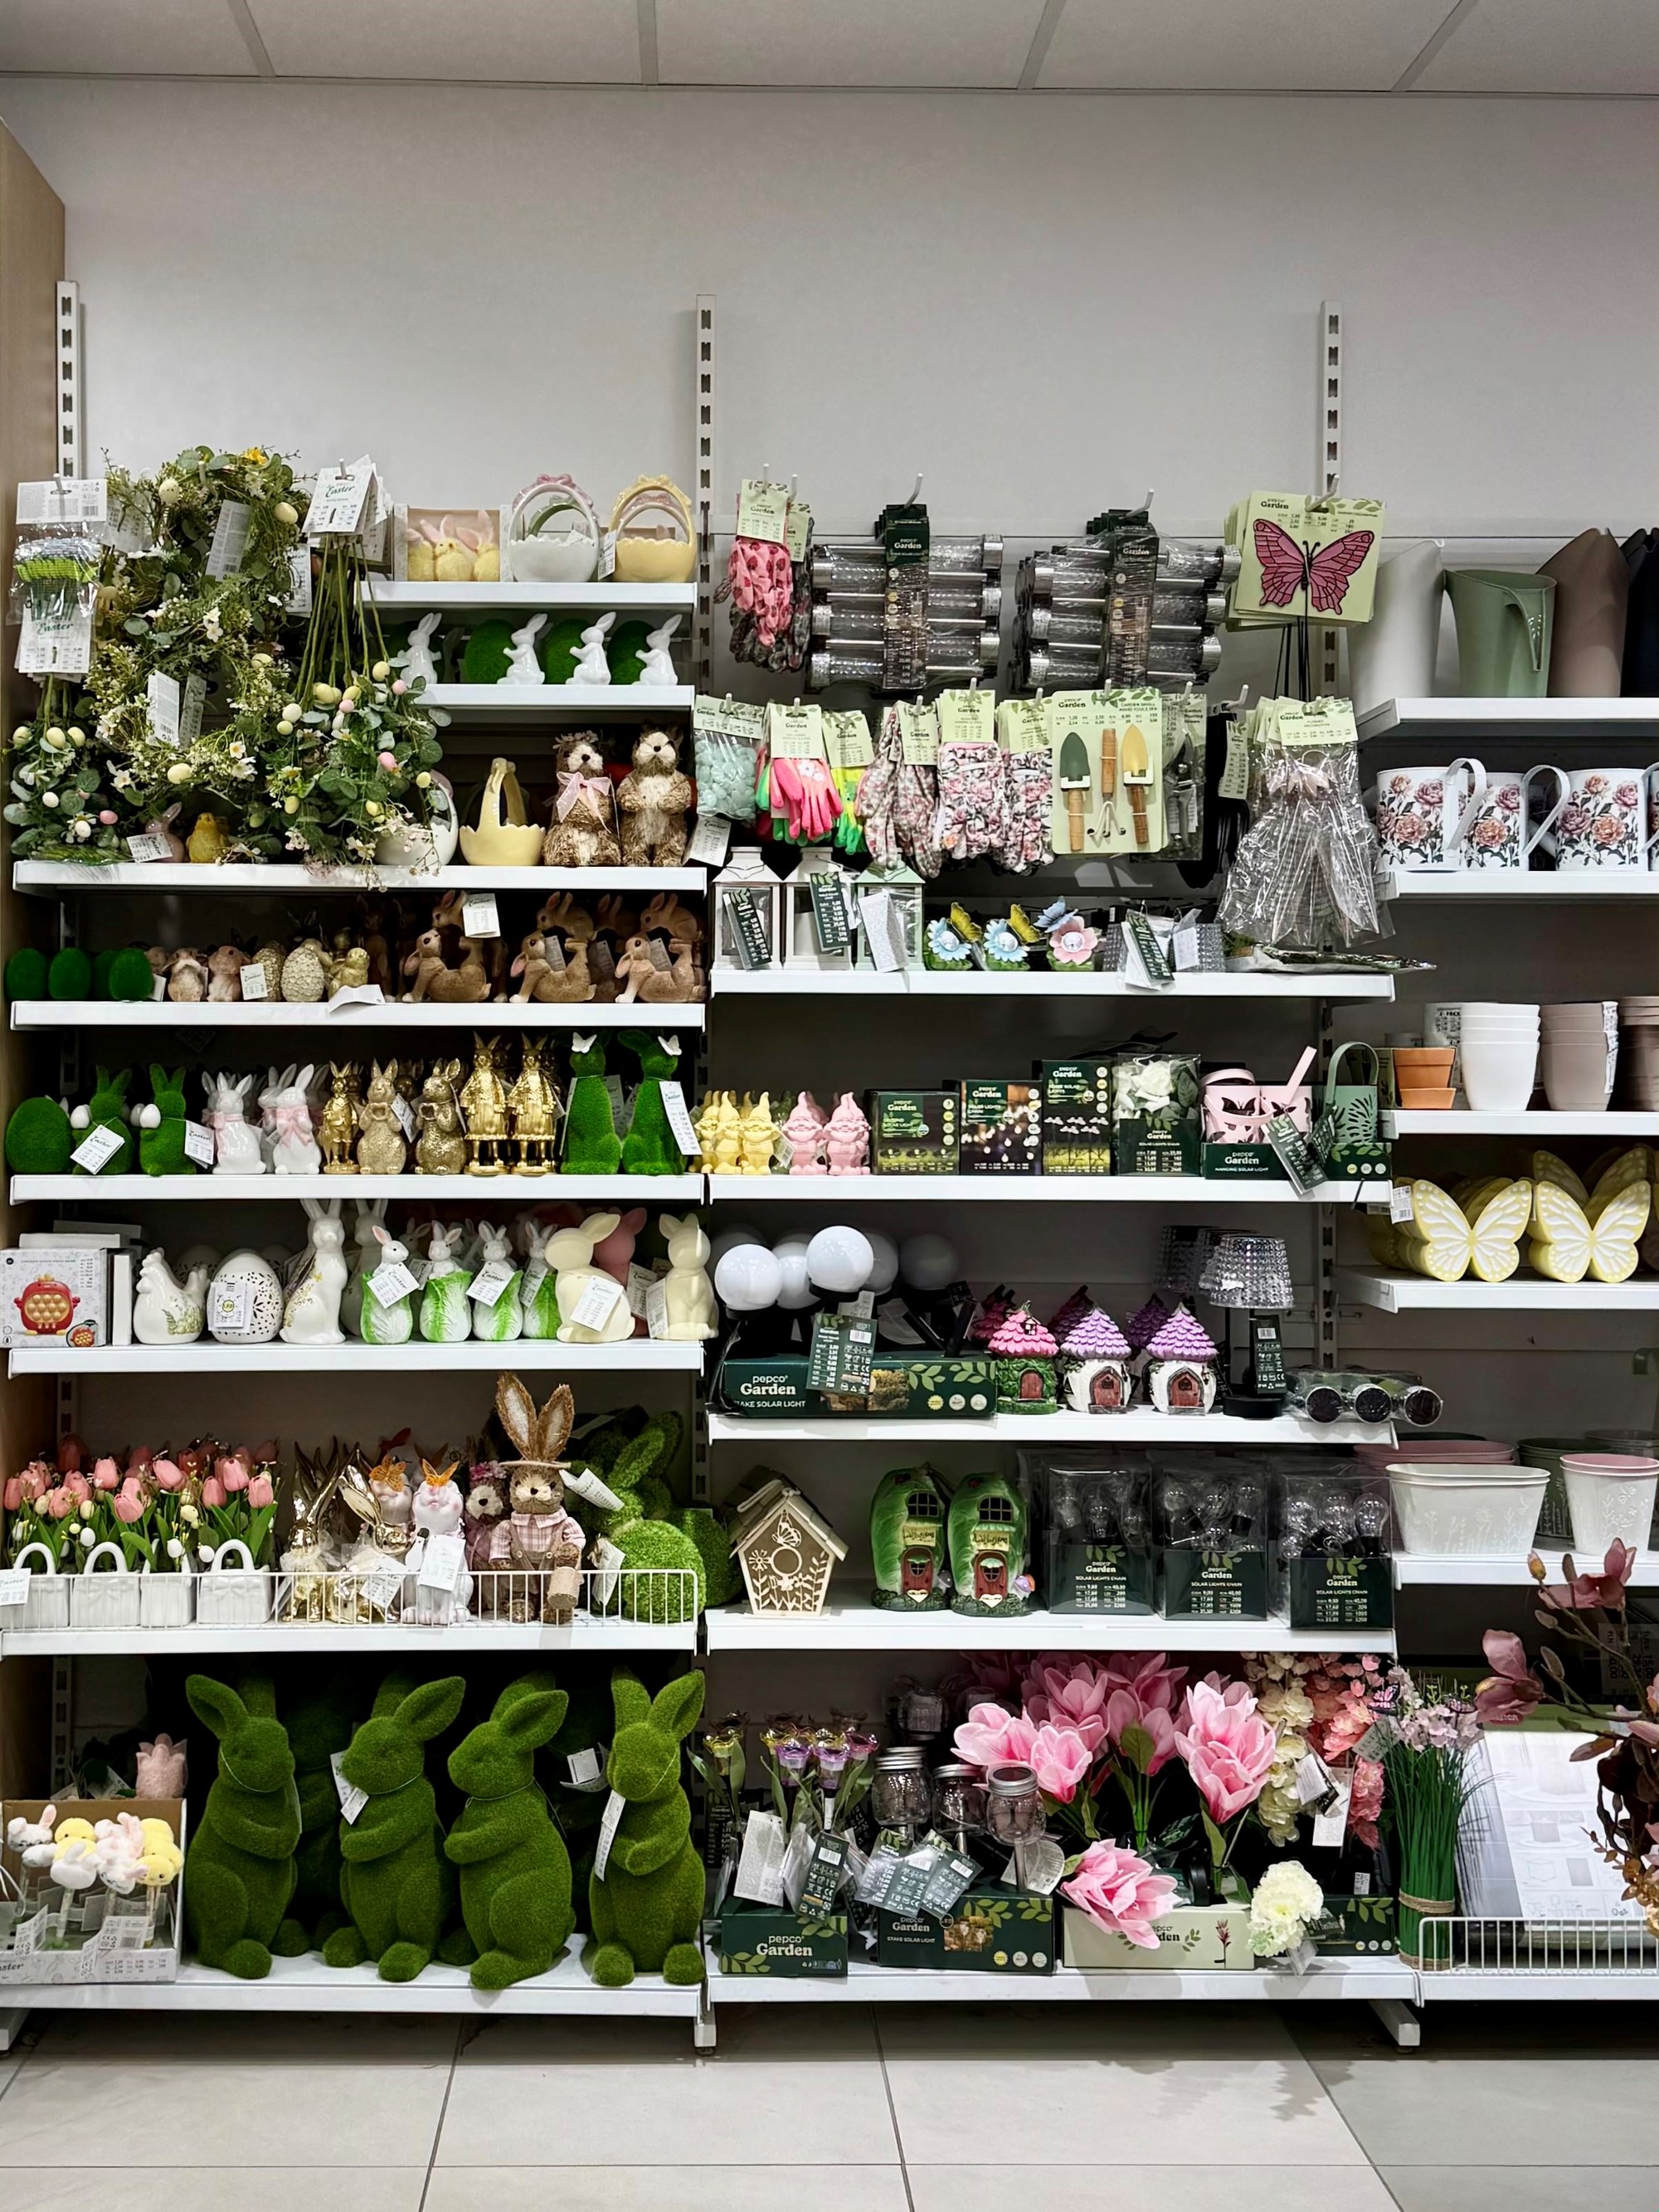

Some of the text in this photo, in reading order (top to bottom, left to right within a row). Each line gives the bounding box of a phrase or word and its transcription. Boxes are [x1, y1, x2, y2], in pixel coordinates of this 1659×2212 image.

[1261, 501, 1288, 509] Garden
[37, 622, 73, 635] Easter
[1224, 1156, 1259, 1164] Garden
[752, 1375, 786, 1383] pepco
[740, 1383, 796, 1395] Garden
[893, 1922, 930, 1932] Garden
[768, 1935, 802, 1943] pepco
[757, 1943, 813, 1956] Garden
